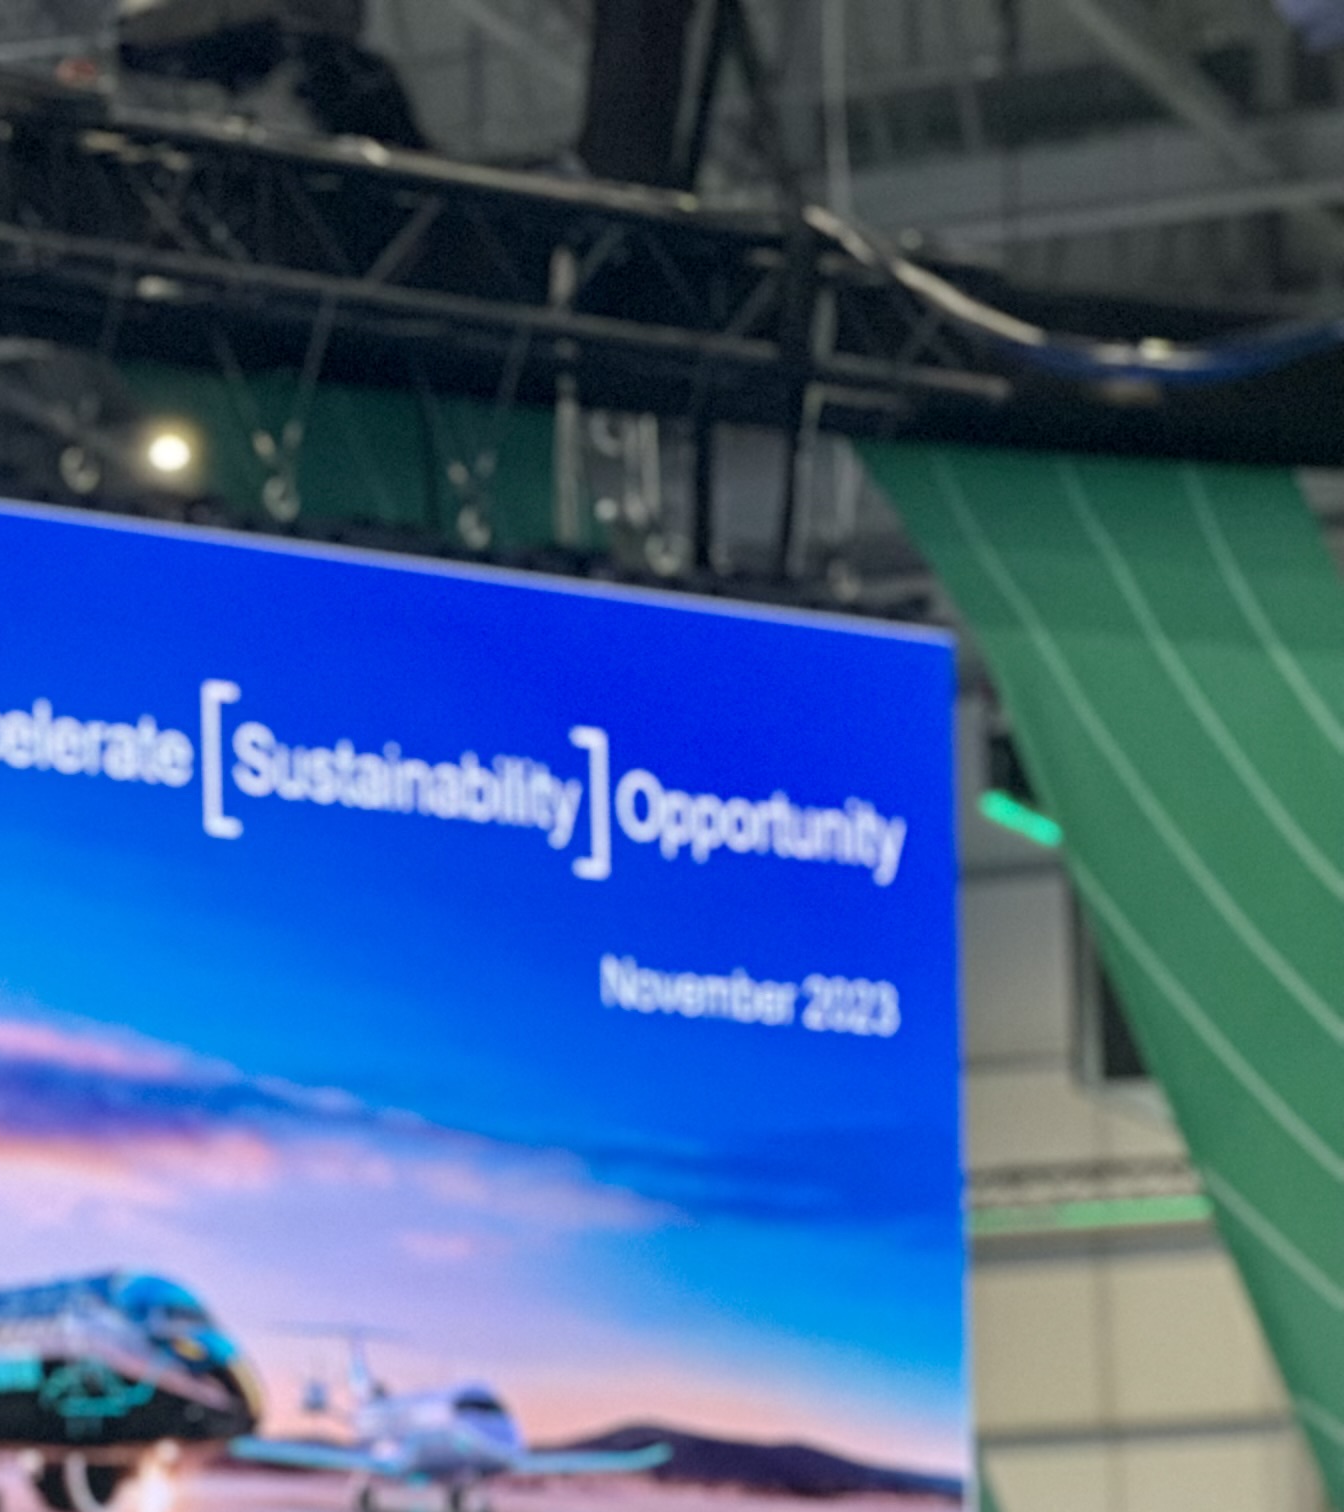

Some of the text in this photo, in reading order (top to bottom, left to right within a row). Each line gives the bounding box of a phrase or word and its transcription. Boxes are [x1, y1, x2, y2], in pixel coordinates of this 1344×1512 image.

[615, 768, 907, 887] Opportunity
[599, 953, 902, 1038] November 2023
